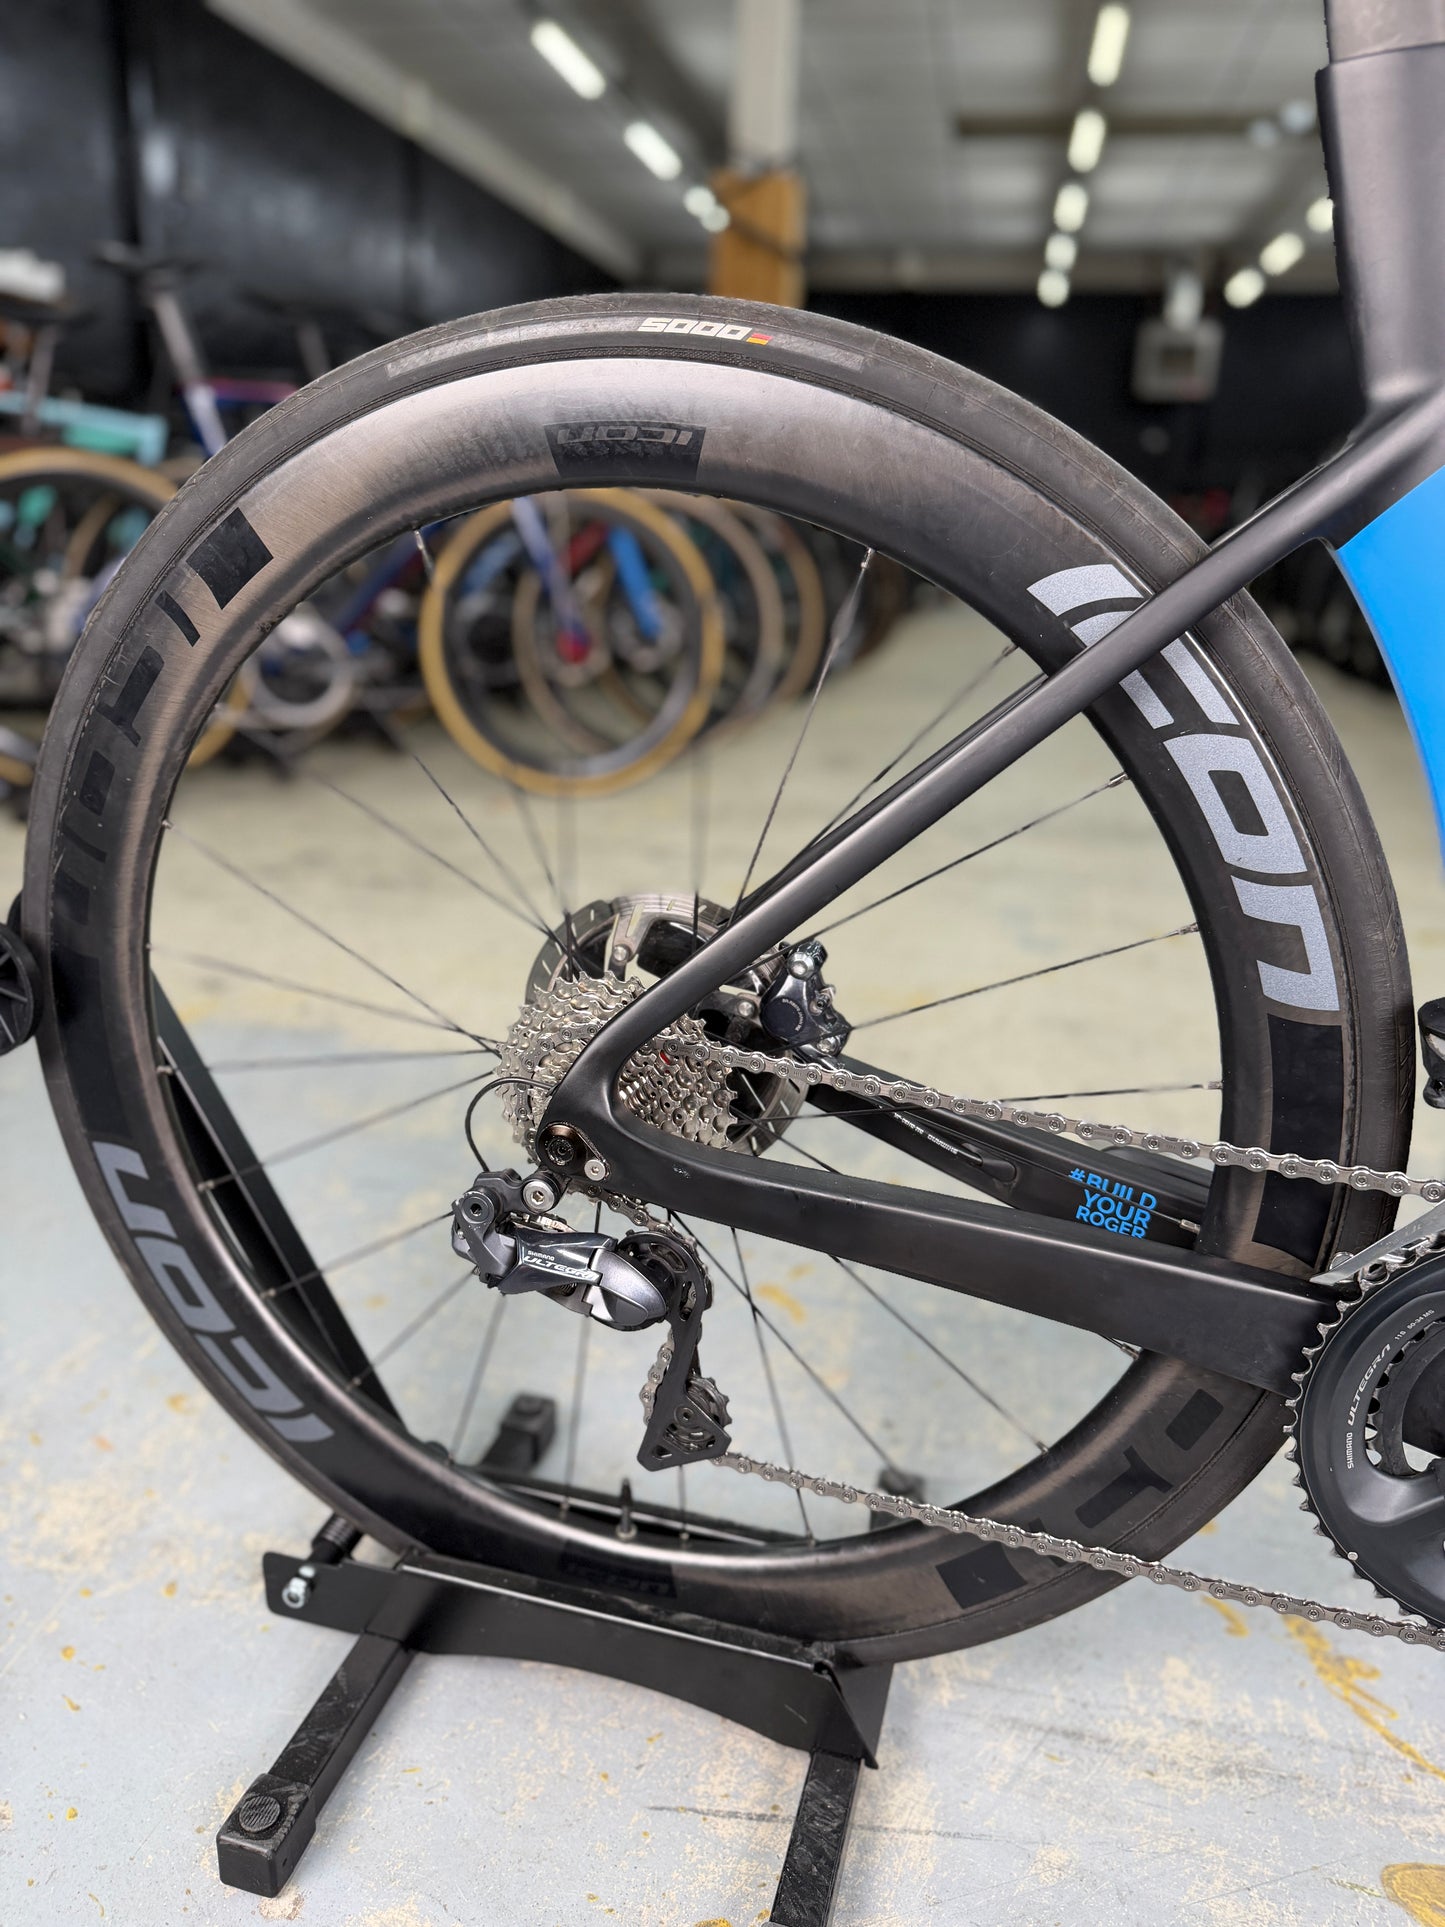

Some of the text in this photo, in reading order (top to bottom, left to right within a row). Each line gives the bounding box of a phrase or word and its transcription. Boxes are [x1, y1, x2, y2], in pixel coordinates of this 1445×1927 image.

[638, 317, 752, 341] 5000
[1068, 1167, 1157, 1211] #BUILD
[1075, 1204, 1147, 1239] ROGER
[1083, 1188, 1151, 1229] YOUR
[527, 1250, 555, 1262] SHIMANO
[1407, 1316, 1424, 1329] 50-34
[1347, 1343, 1391, 1426] ULTEGRA
[1346, 1432, 1354, 1470] SHIMANO
